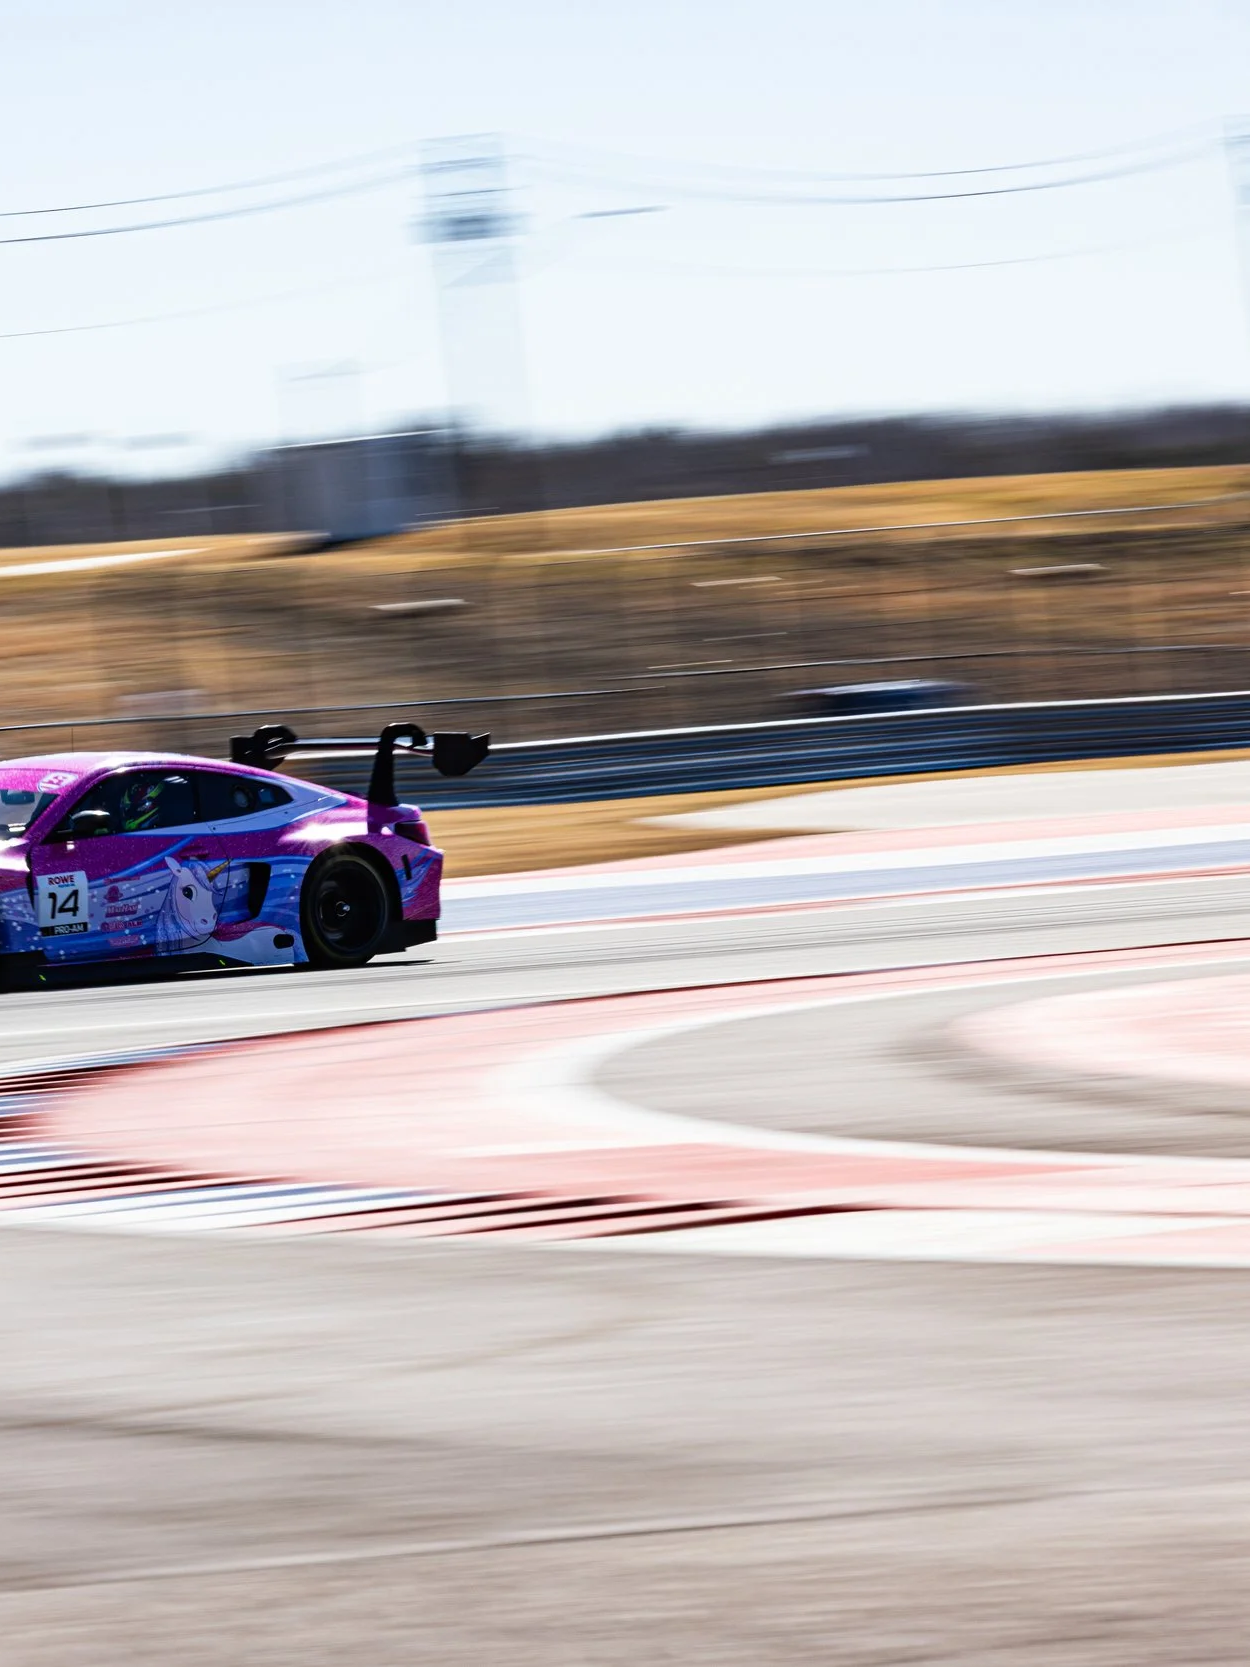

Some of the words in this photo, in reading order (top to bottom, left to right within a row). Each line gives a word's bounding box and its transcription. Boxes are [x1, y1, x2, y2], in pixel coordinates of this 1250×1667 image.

[48, 875, 74, 885] ROWE
[48, 889, 79, 919] 14
[54, 923, 84, 934] PRO-AM
